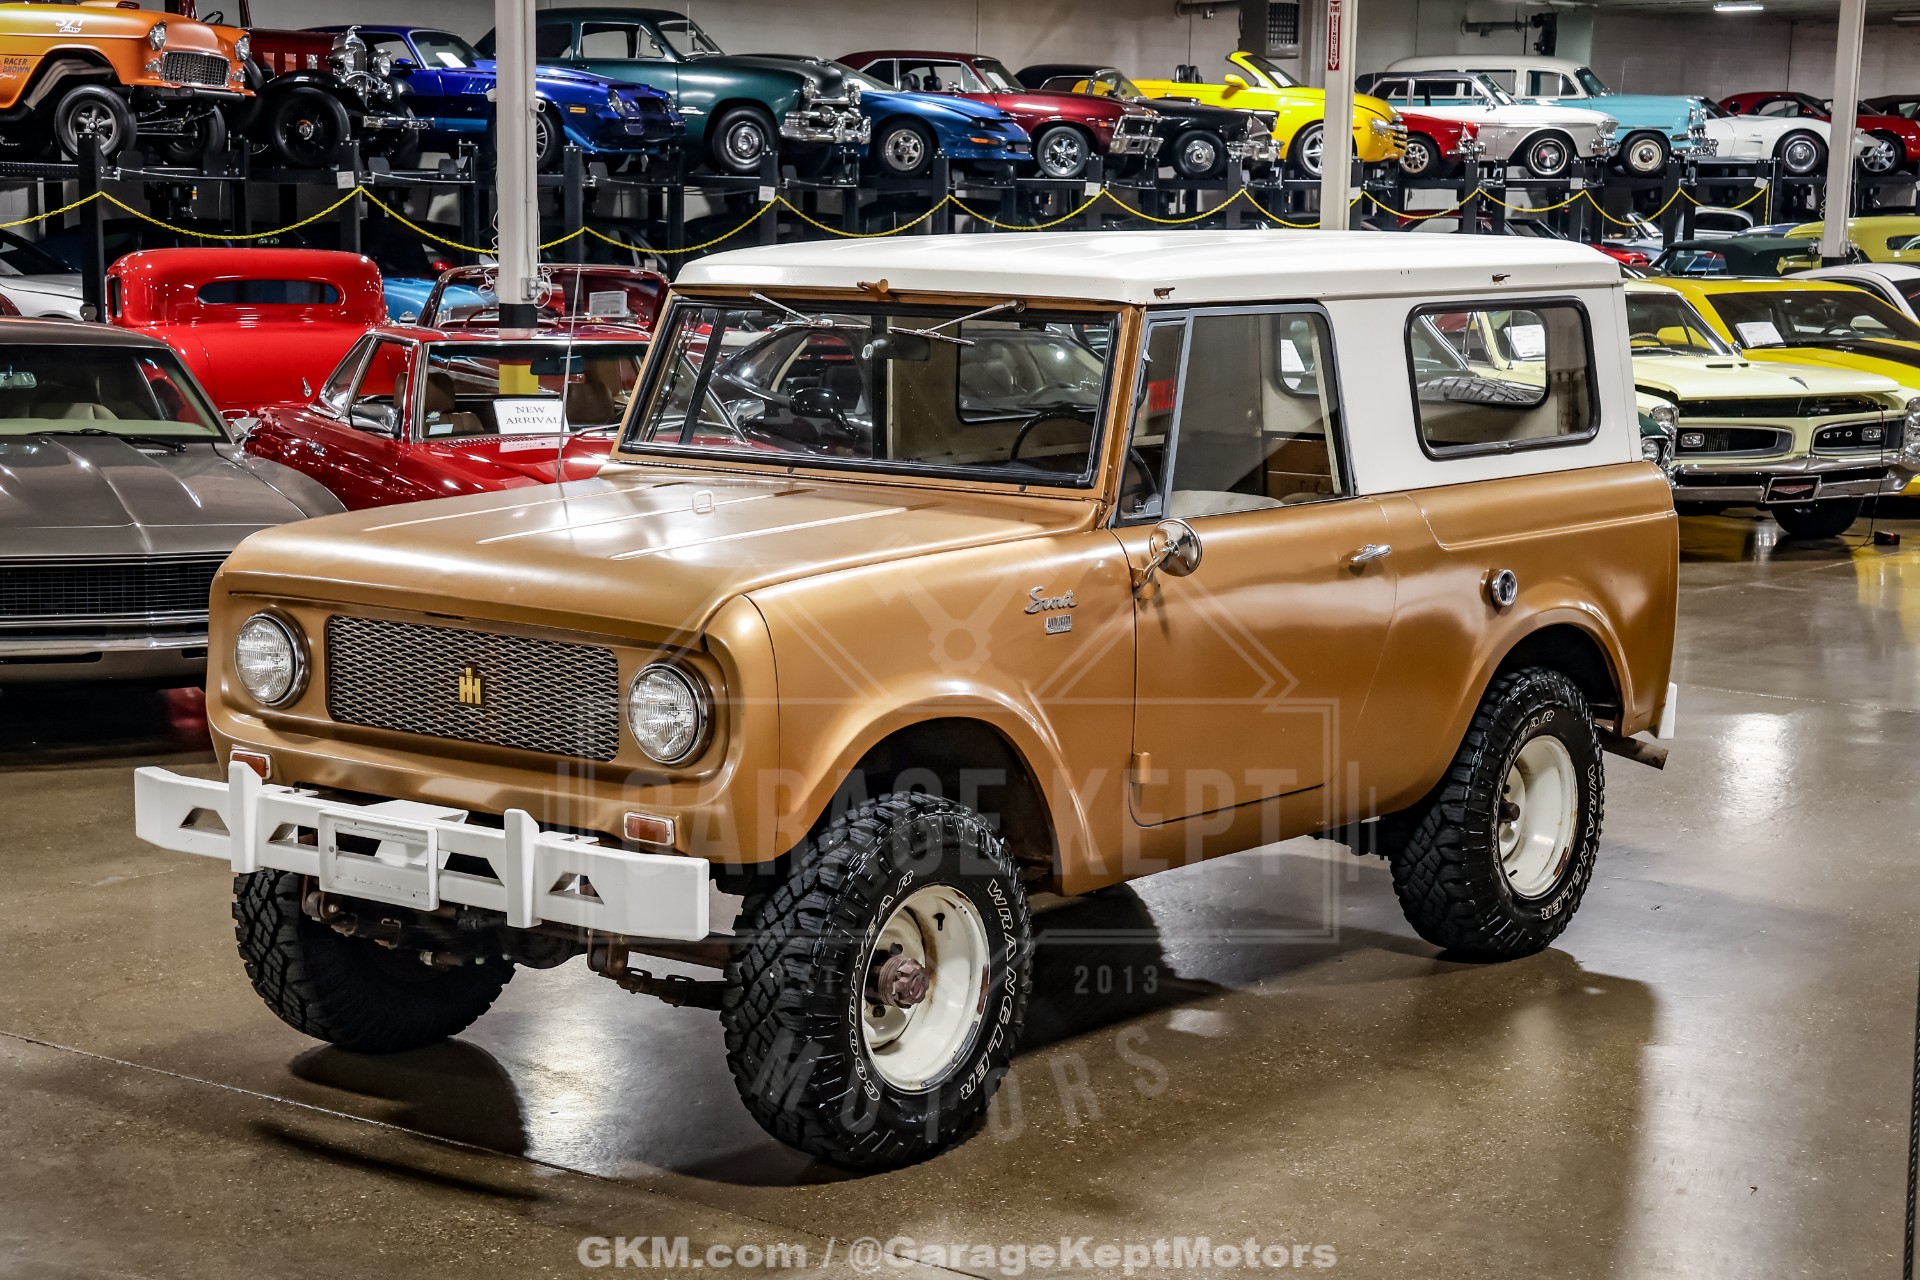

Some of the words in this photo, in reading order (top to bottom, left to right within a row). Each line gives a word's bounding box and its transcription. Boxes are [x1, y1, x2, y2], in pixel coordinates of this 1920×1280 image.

[3, 57, 28, 66] RACER
[515, 406, 545, 414] NEW
[505, 416, 563, 425] ARRIVAL
[1822, 430, 1853, 439] GTO
[1541, 764, 1598, 921] WRANGLER
[959, 878, 1017, 1100] WRANGLER
